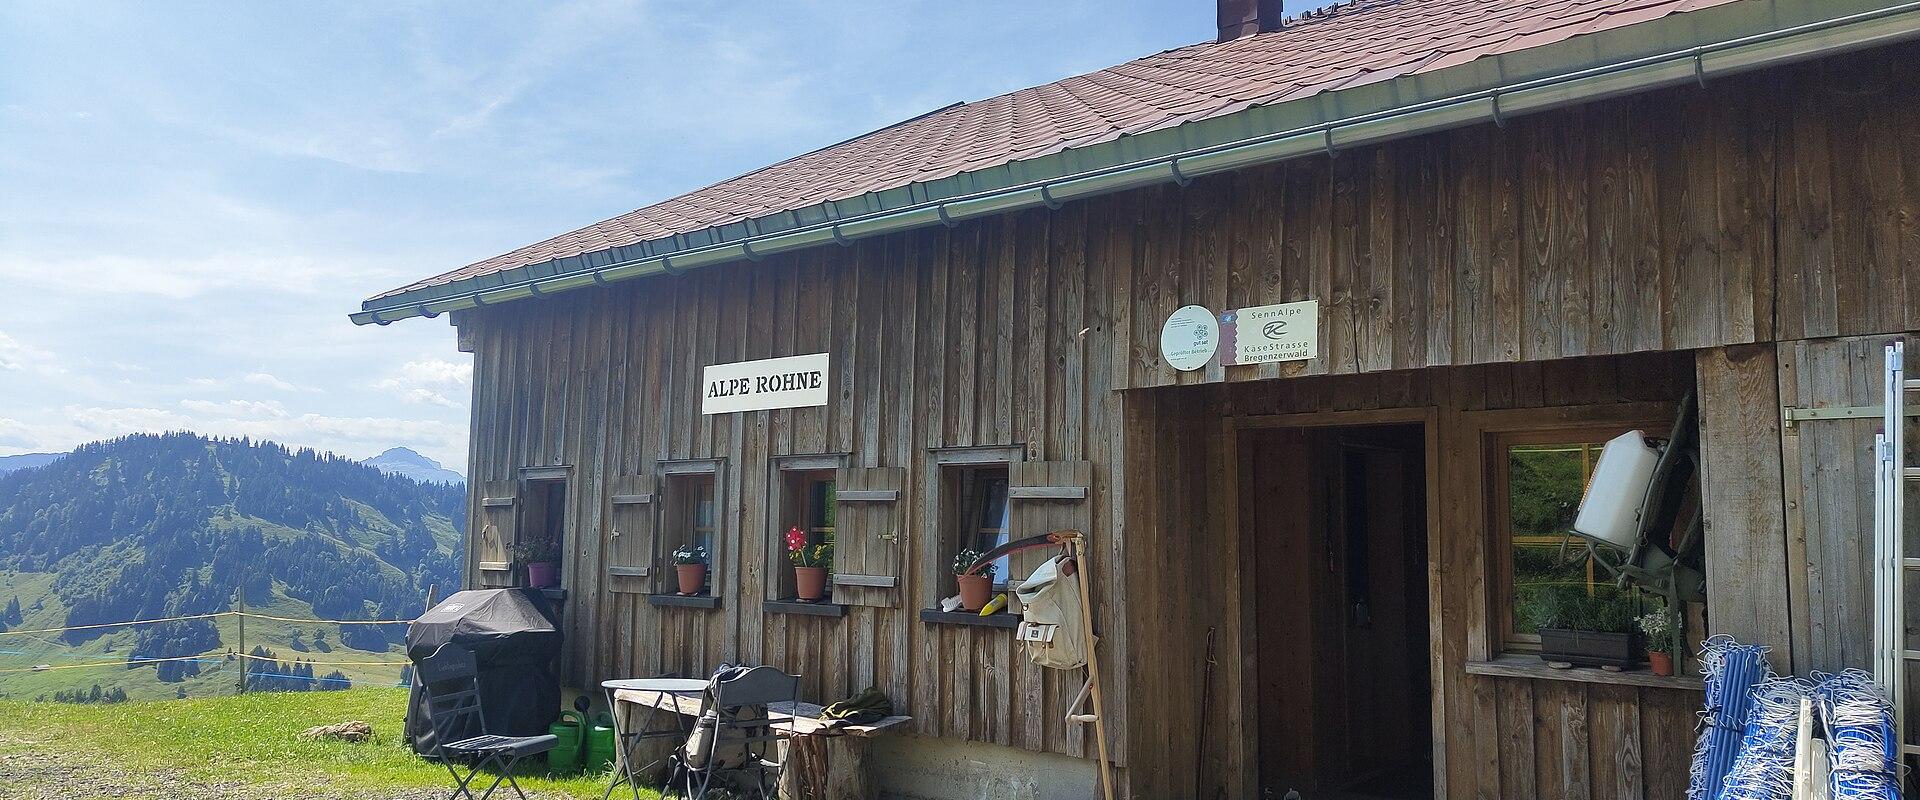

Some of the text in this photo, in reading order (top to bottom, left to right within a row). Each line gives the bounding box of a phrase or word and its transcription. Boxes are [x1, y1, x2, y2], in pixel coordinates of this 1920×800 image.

[1251, 308, 1302, 319] SennAlpe
[1244, 341, 1308, 353] KäseStrasse
[1244, 349, 1308, 362] Bregenzerwald
[708, 370, 822, 398] ALPE ROHNE
